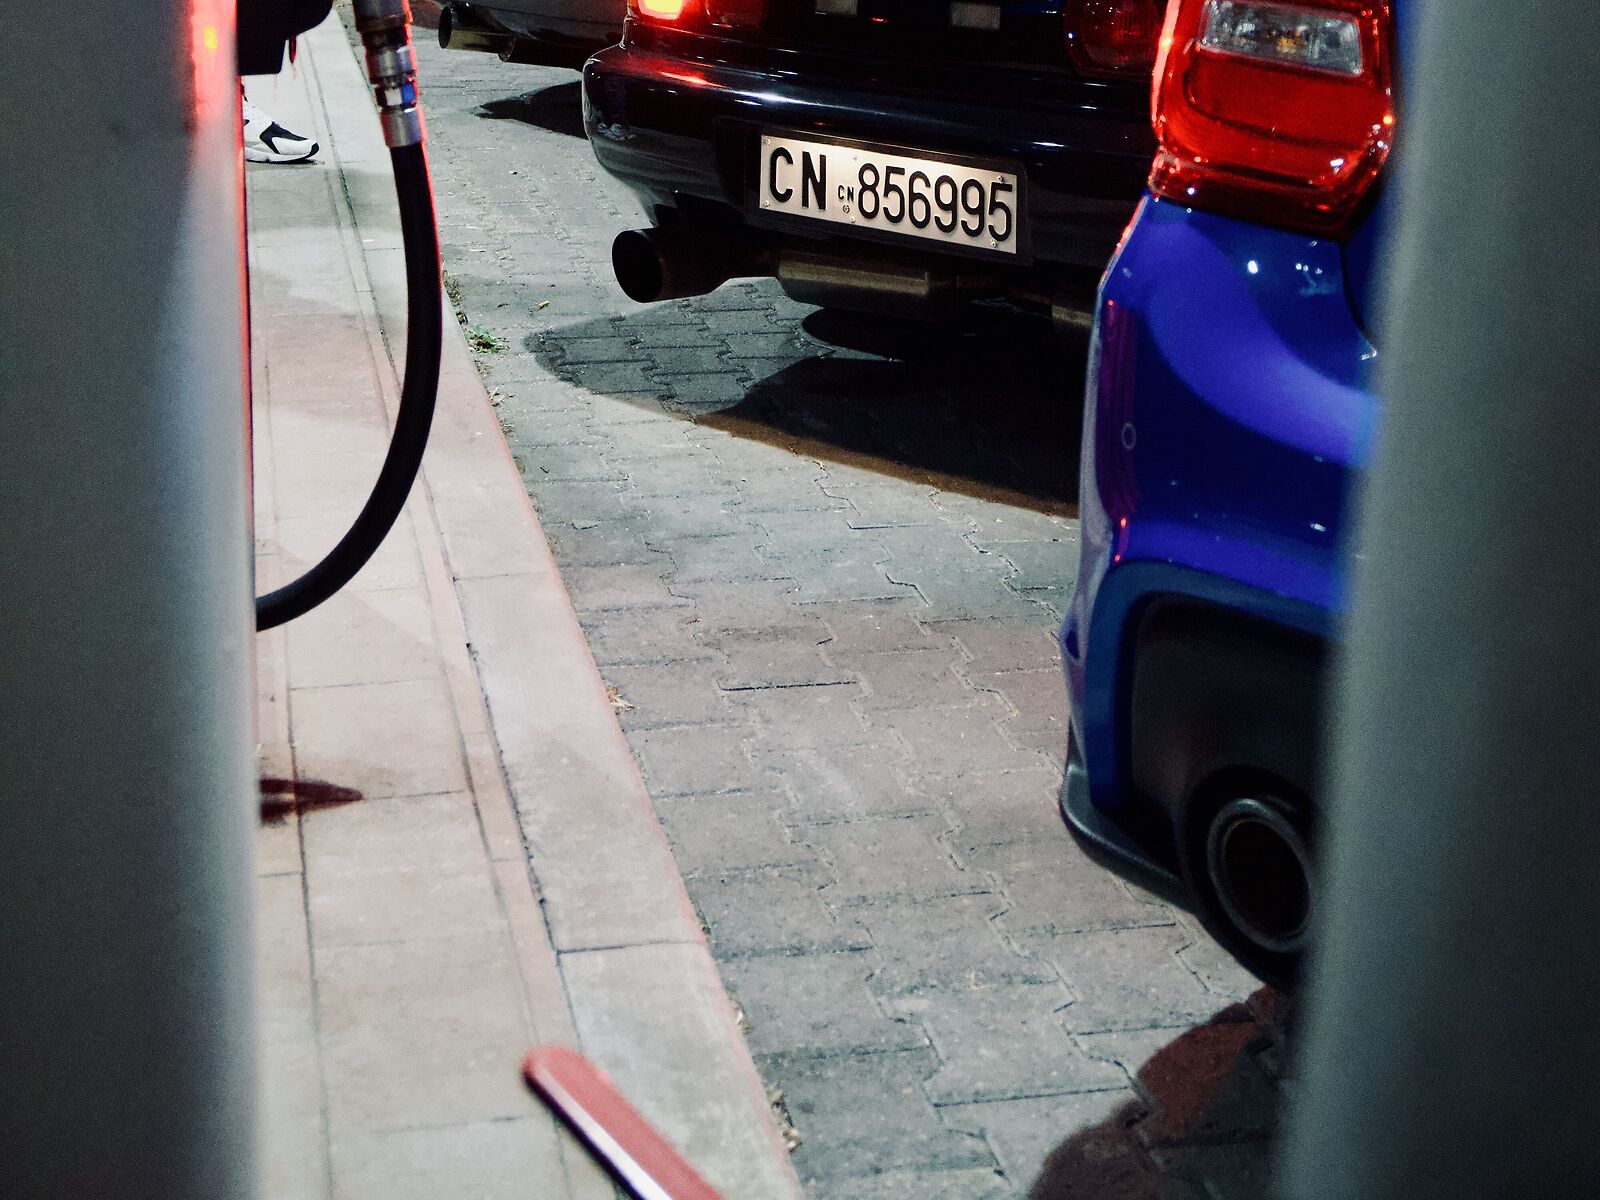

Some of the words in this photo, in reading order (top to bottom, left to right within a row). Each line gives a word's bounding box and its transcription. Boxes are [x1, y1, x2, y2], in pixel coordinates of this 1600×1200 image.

[769, 146, 827, 211] CN
[838, 184, 854, 202] CN
[857, 163, 1013, 242] 856995
